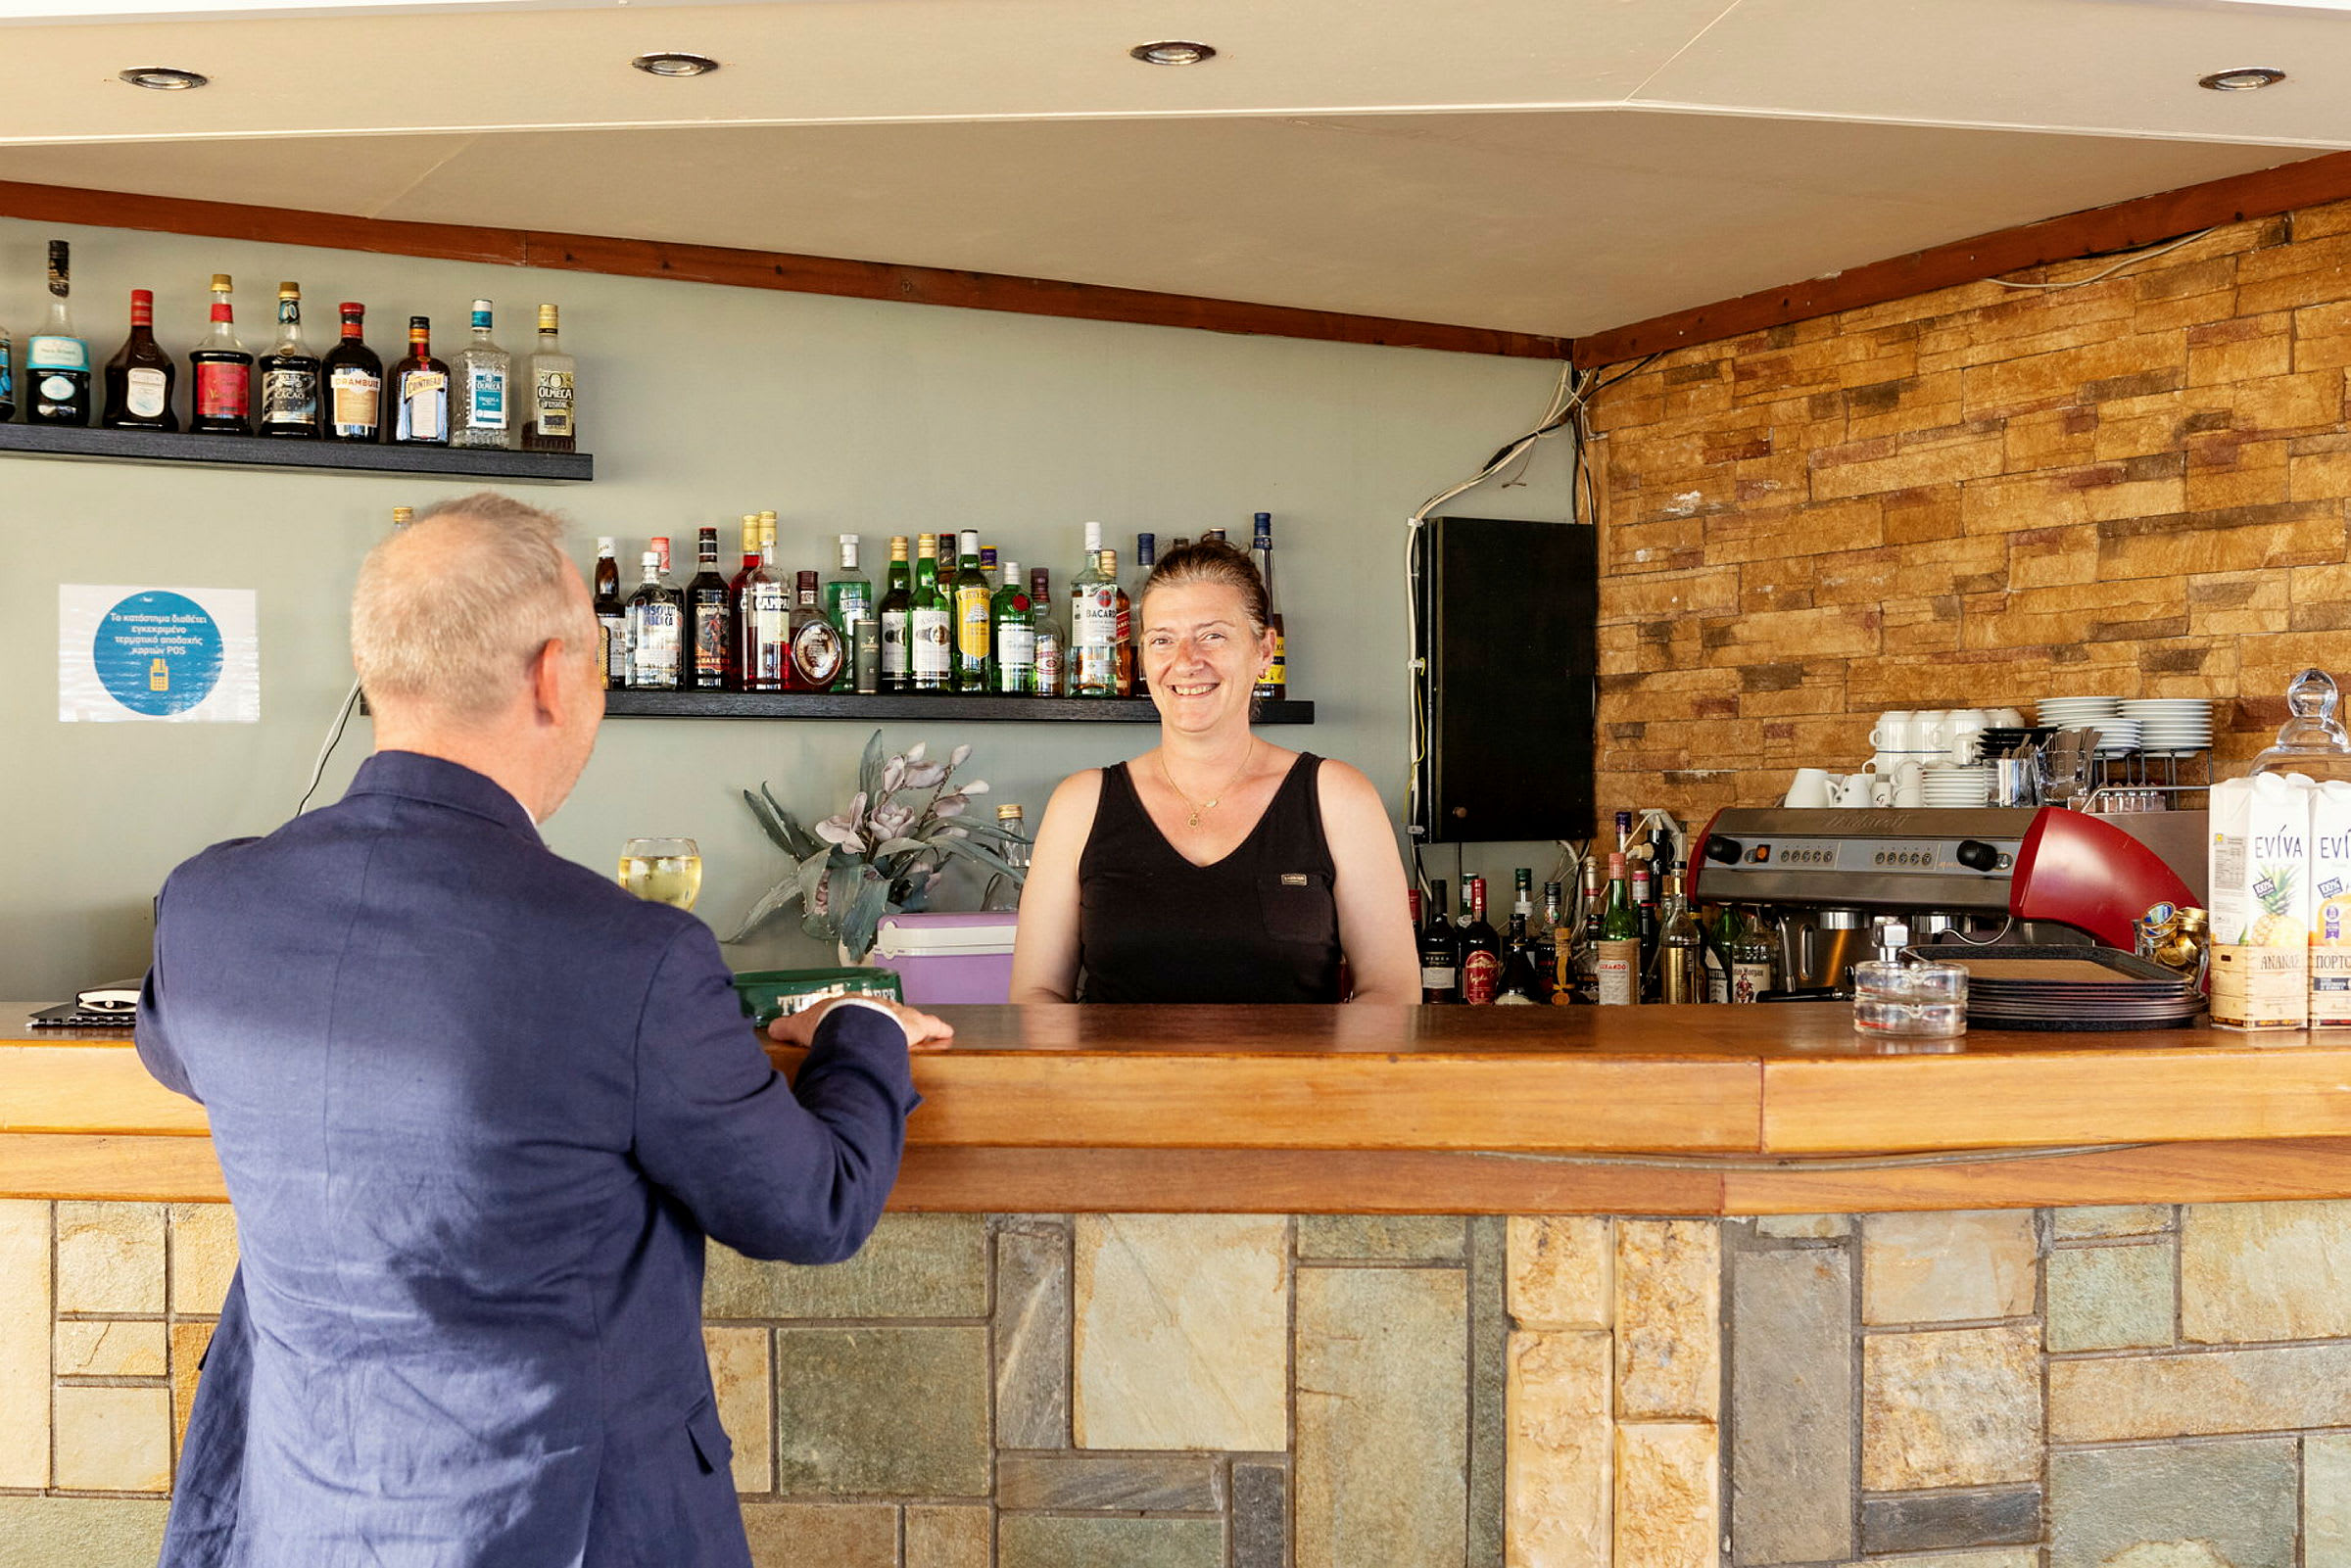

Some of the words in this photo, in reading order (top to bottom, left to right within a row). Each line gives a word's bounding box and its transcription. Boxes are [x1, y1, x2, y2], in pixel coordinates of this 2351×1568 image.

[335, 378, 379, 388] DRAMBUIE
[408, 376, 443, 394] COINTREAU
[476, 382, 502, 391] OLMECA
[538, 386, 572, 399] OLMECA
[2255, 824, 2303, 859] EVÍVA
